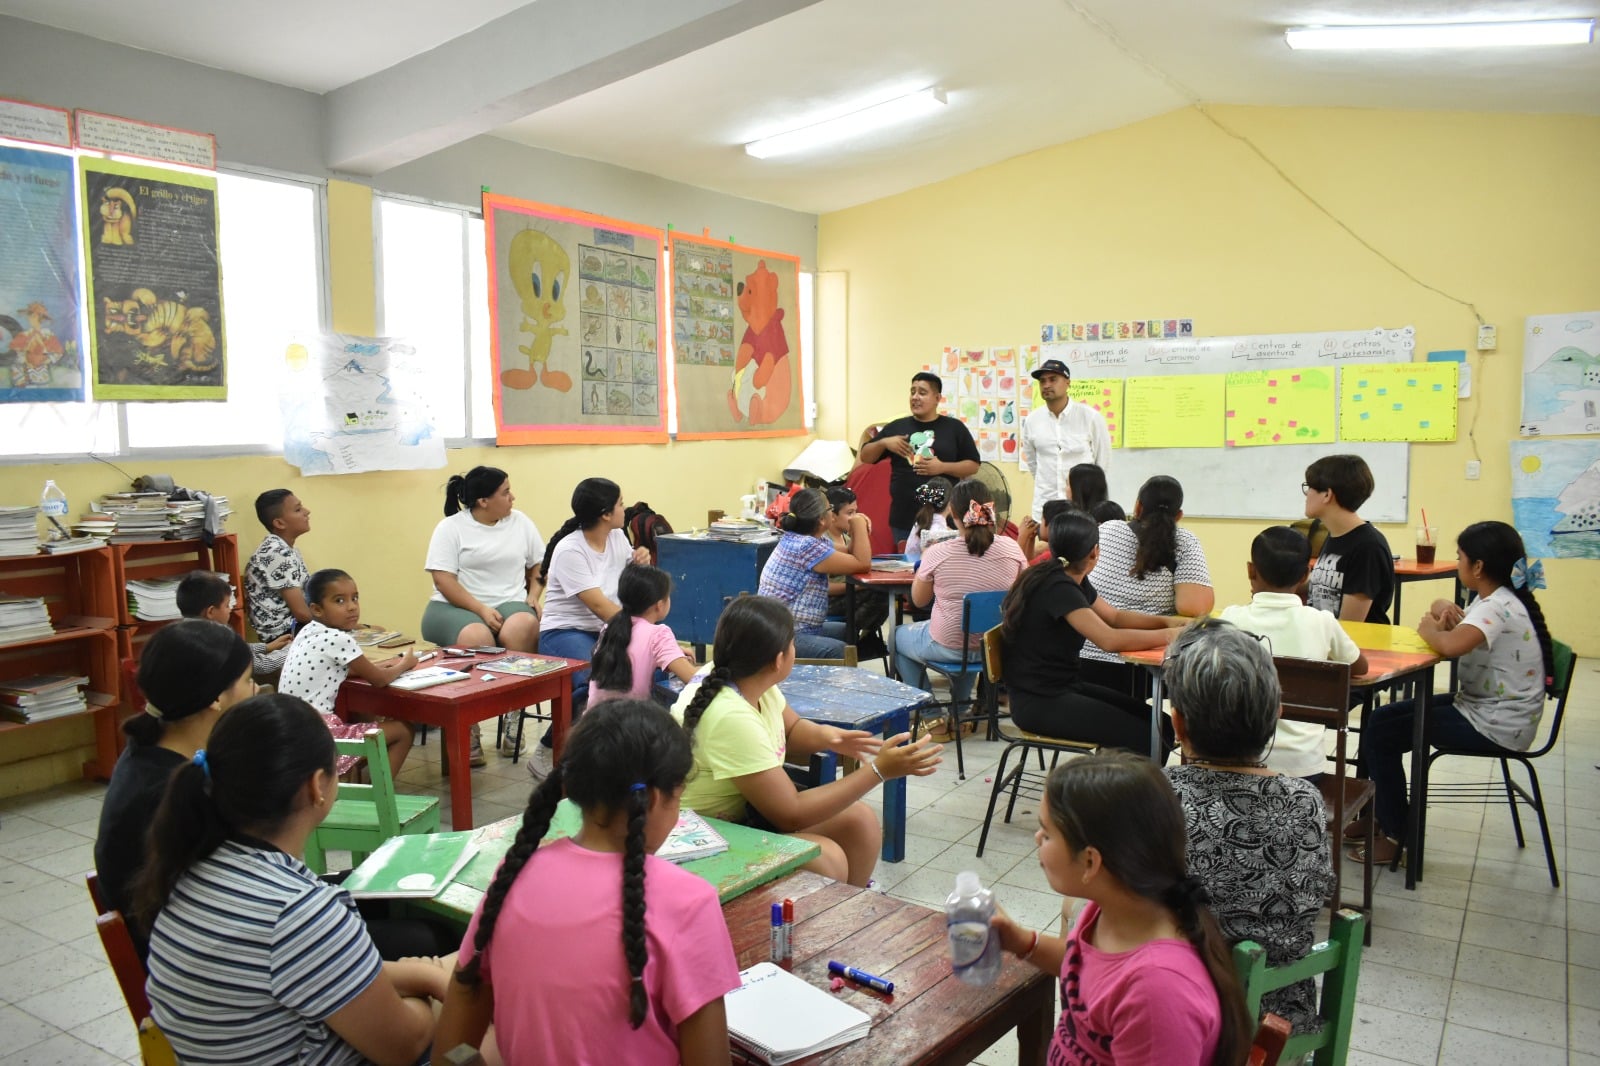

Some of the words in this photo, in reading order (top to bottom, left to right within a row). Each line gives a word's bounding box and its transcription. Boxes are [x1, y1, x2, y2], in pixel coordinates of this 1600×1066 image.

[139, 185, 149, 196] El
[151, 189, 173, 201] grillo
[189, 194, 208, 205] tigre
[1181, 322, 1192, 333] 10
[1251, 341, 1286, 350] Centros
[1292, 340, 1301, 349] de
[1343, 338, 1381, 349] Centros
[1084, 349, 1115, 361] Lugares
[1119, 347, 1128, 355] de
[1256, 349, 1296, 357] aventura
[1343, 347, 1395, 358] artesanales
